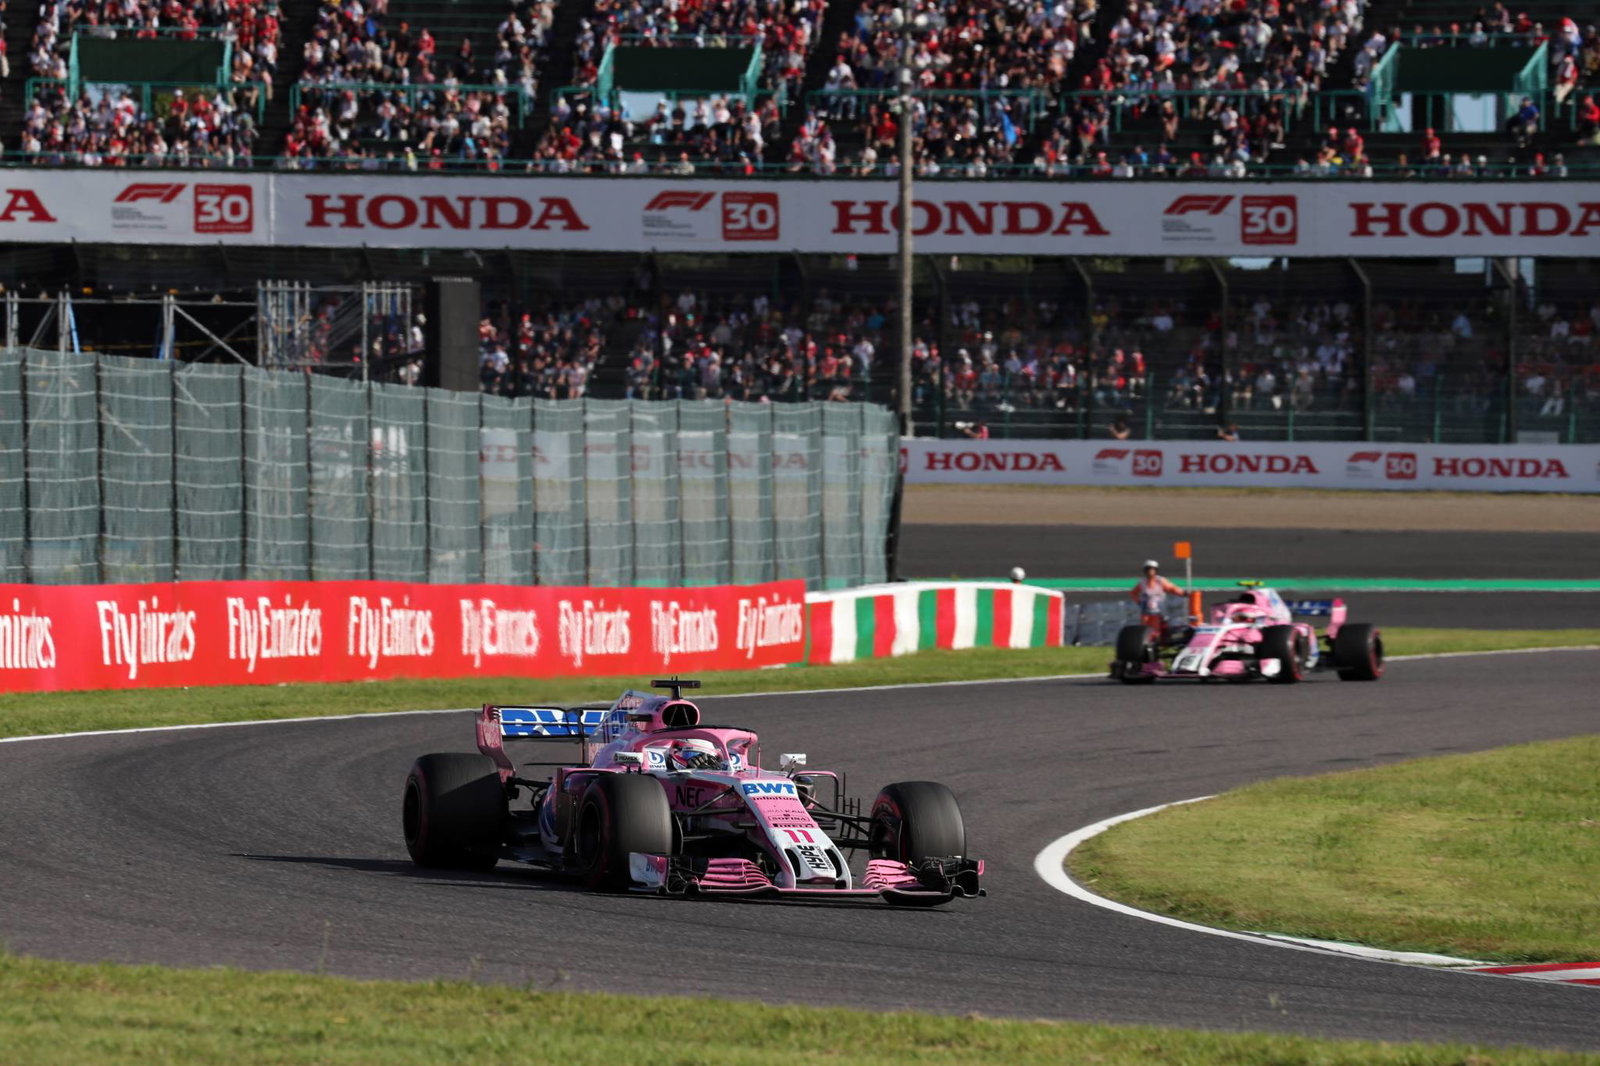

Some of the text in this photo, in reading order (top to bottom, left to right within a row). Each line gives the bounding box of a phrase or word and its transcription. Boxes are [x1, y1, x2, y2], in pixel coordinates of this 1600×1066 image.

[197, 195, 249, 223] 30
[305, 194, 590, 231] HONDA
[725, 203, 775, 231] 30
[831, 200, 1110, 236] HONDA
[1244, 206, 1293, 234] 30
[924, 451, 1066, 472] HONDA
[1178, 453, 1320, 474] HONDA
[1432, 456, 1570, 479] HONDA
[96, 600, 138, 680] Fly
[226, 597, 258, 674] Fly
[348, 596, 380, 670] Fly
[675, 785, 705, 808] NEC
[742, 783, 795, 795] BWT
[782, 829, 815, 844] 11
